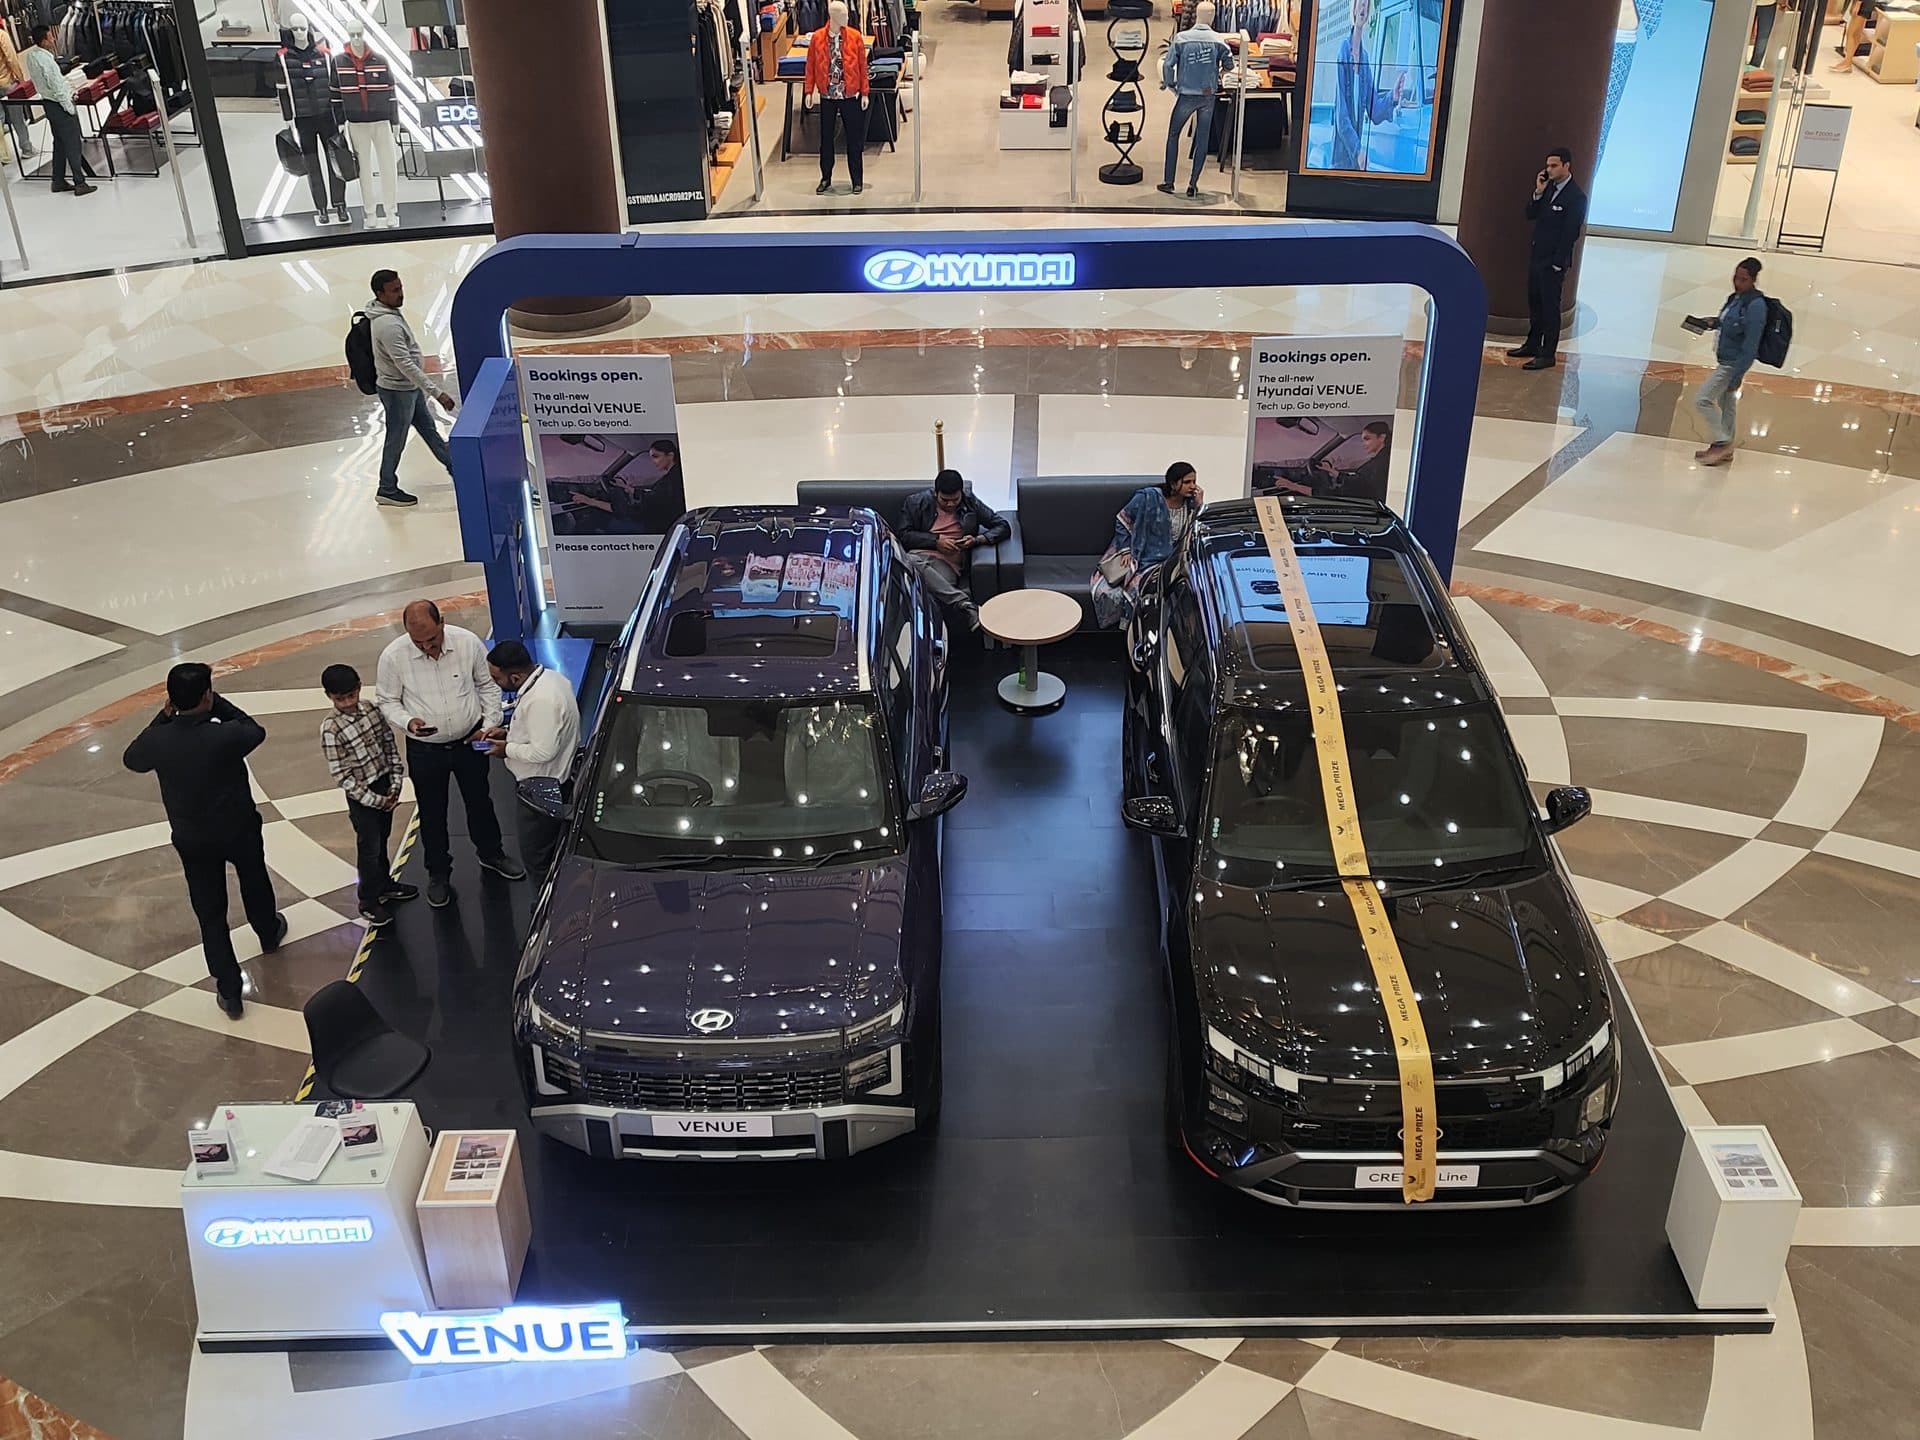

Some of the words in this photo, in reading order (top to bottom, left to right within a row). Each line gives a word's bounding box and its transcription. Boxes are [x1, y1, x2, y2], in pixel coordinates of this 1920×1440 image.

[437, 104, 478, 121] EDG
[929, 260, 1071, 282] HYUNDAI
[1259, 351, 1326, 364] Bookings
[1330, 352, 1371, 364] open.
[529, 369, 598, 383] Bookings
[600, 371, 643, 383] open.
[1258, 375, 1276, 383] The
[1278, 374, 1314, 383] all-new
[532, 393, 551, 401] The
[553, 393, 589, 401] all-new
[1256, 385, 1314, 398] Hyundai
[1316, 384, 1367, 396] VENUE.
[534, 403, 592, 416] Hyundai
[594, 403, 646, 414] VENUE.
[1256, 402, 1278, 411] Tech
[1280, 403, 1295, 412] up.
[1297, 401, 1311, 410] Go
[1312, 400, 1350, 411] beyond.
[537, 419, 559, 427] Tech
[561, 420, 576, 429] up.
[578, 419, 592, 427] Go
[593, 419, 632, 429] beyond.
[555, 543, 589, 551] Please
[591, 543, 631, 551] contact
[632, 542, 655, 551] here
[1331, 760, 1341, 784] PRIZE
[1335, 785, 1346, 811] MEGA
[1389, 974, 1402, 996] PRIZE
[1396, 997, 1409, 1021] MEGA
[1414, 1106, 1424, 1133] PRIZE
[678, 1121, 748, 1133] VENUE
[1415, 1134, 1423, 1161] MEGA
[1368, 1173, 1404, 1182] CRE
[1439, 1172, 1468, 1182] Line
[254, 1226, 368, 1243] HYUNDAI
[397, 1321, 614, 1357] VENUE
